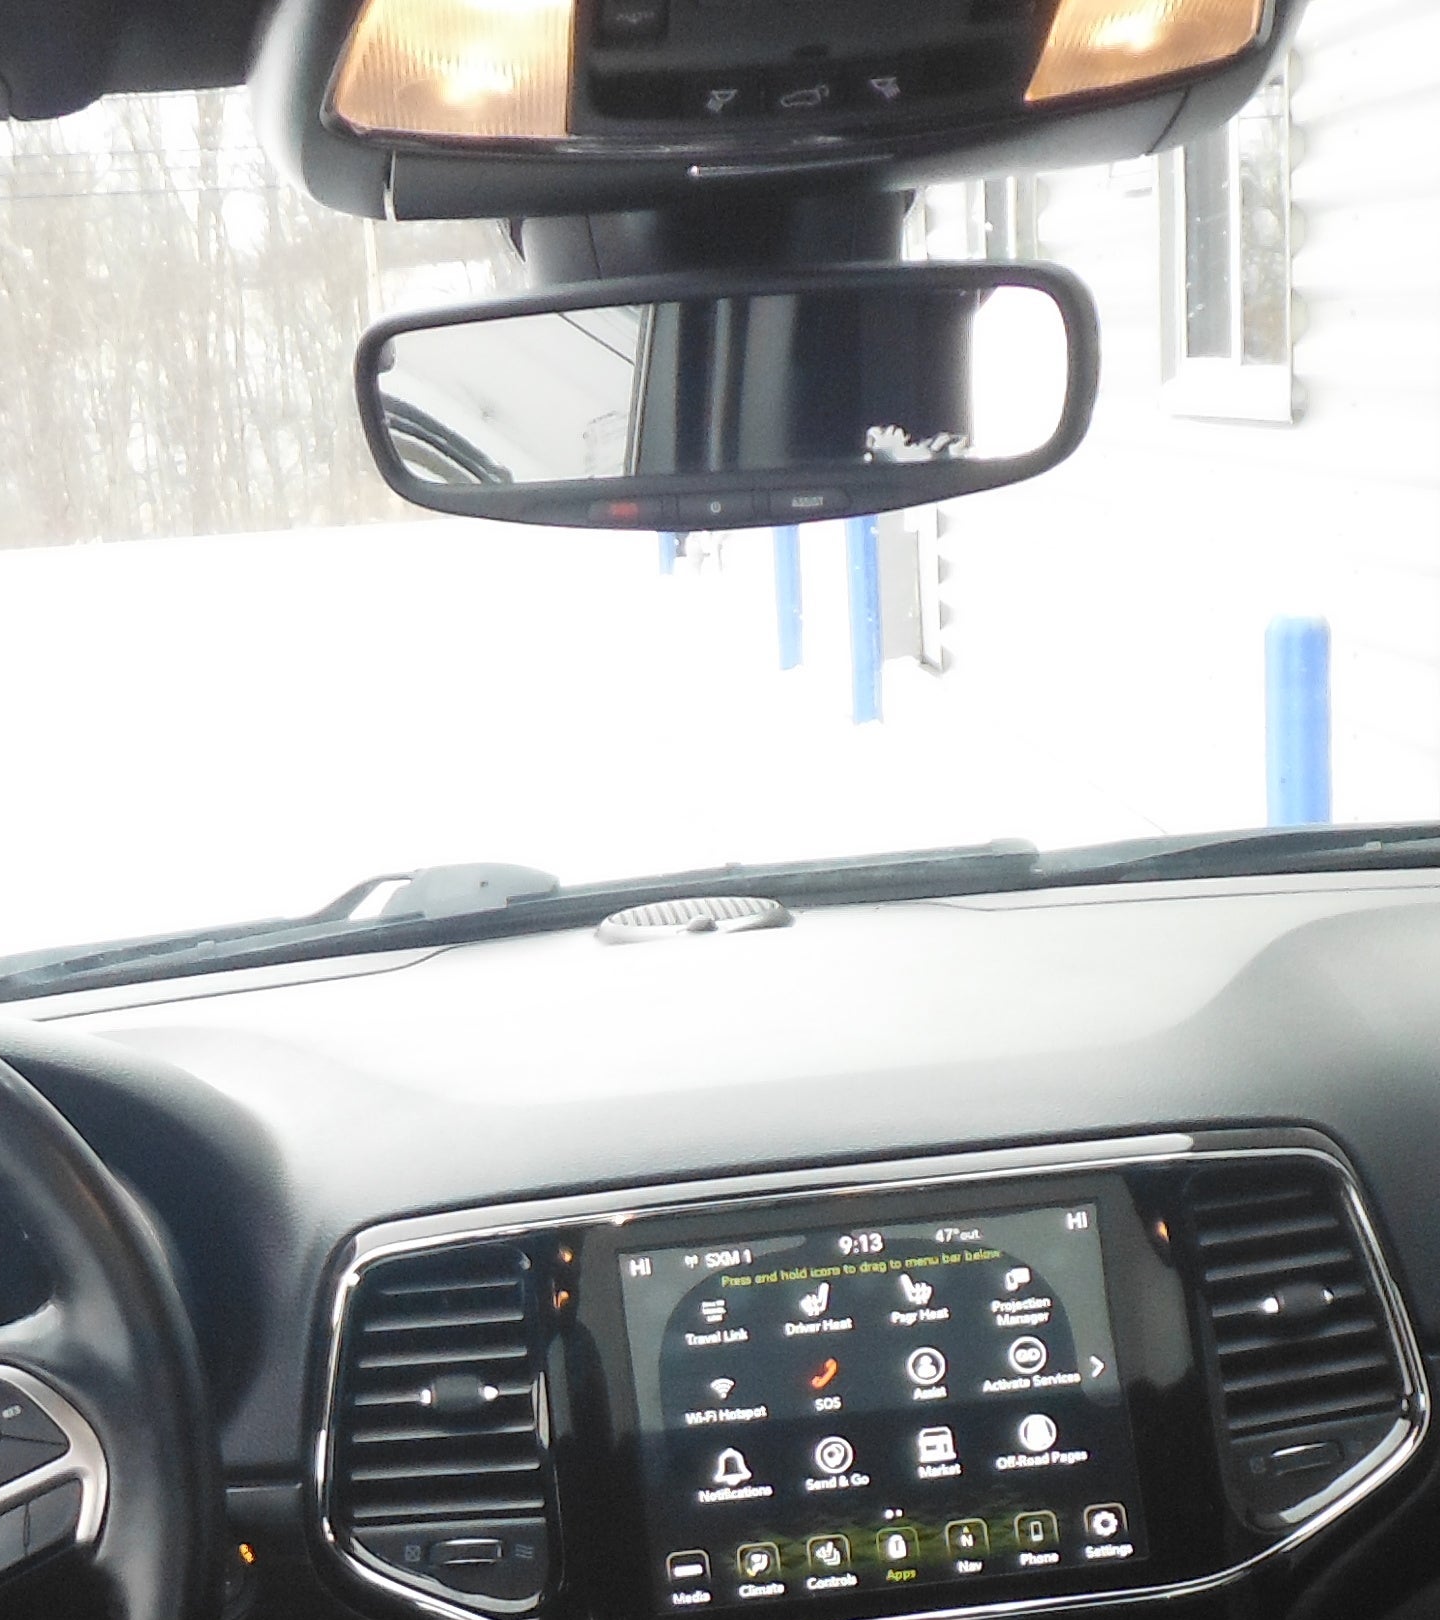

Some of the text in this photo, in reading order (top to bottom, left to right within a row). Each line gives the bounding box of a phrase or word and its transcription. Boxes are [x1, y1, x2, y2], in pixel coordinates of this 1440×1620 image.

[1066, 1211, 1088, 1230] HI
[839, 1232, 883, 1255] 9:13
[630, 1257, 652, 1276] HI
[705, 1249, 752, 1268] SXM 1
[722, 1275, 751, 1287] Press
[755, 1271, 777, 1284] and
[781, 1268, 807, 1281] hold
[843, 1264, 856, 1275] to
[860, 1260, 887, 1274] drag
[889, 1259, 902, 1270] to
[905, 1257, 939, 1268] menu
[942, 1252, 961, 1264] bar
[965, 1249, 1001, 1261] below
[919, 1307, 950, 1321] Heat
[991, 1297, 1051, 1314] Projection
[785, 1317, 853, 1337] Driver Heat
[996, 1311, 1050, 1327] Manager
[685, 1328, 748, 1346] Travel Link
[982, 1372, 1081, 1392] Activate Services
[815, 1396, 842, 1411] SOS
[685, 1405, 768, 1425] Wi-Fi Hotspot
[996, 1450, 1088, 1470] Off-Road Pages
[918, 1463, 961, 1478] Market
[805, 1473, 870, 1491] Send & Go
[698, 1485, 773, 1502] Notifications
[1020, 1552, 1060, 1566] Phone
[1085, 1544, 1134, 1559] Settings
[958, 1560, 983, 1573] Nav
[806, 1573, 858, 1590] Controls
[886, 1569, 917, 1582] Apps
[672, 1590, 711, 1605] Media
[738, 1583, 785, 1599] Climate
